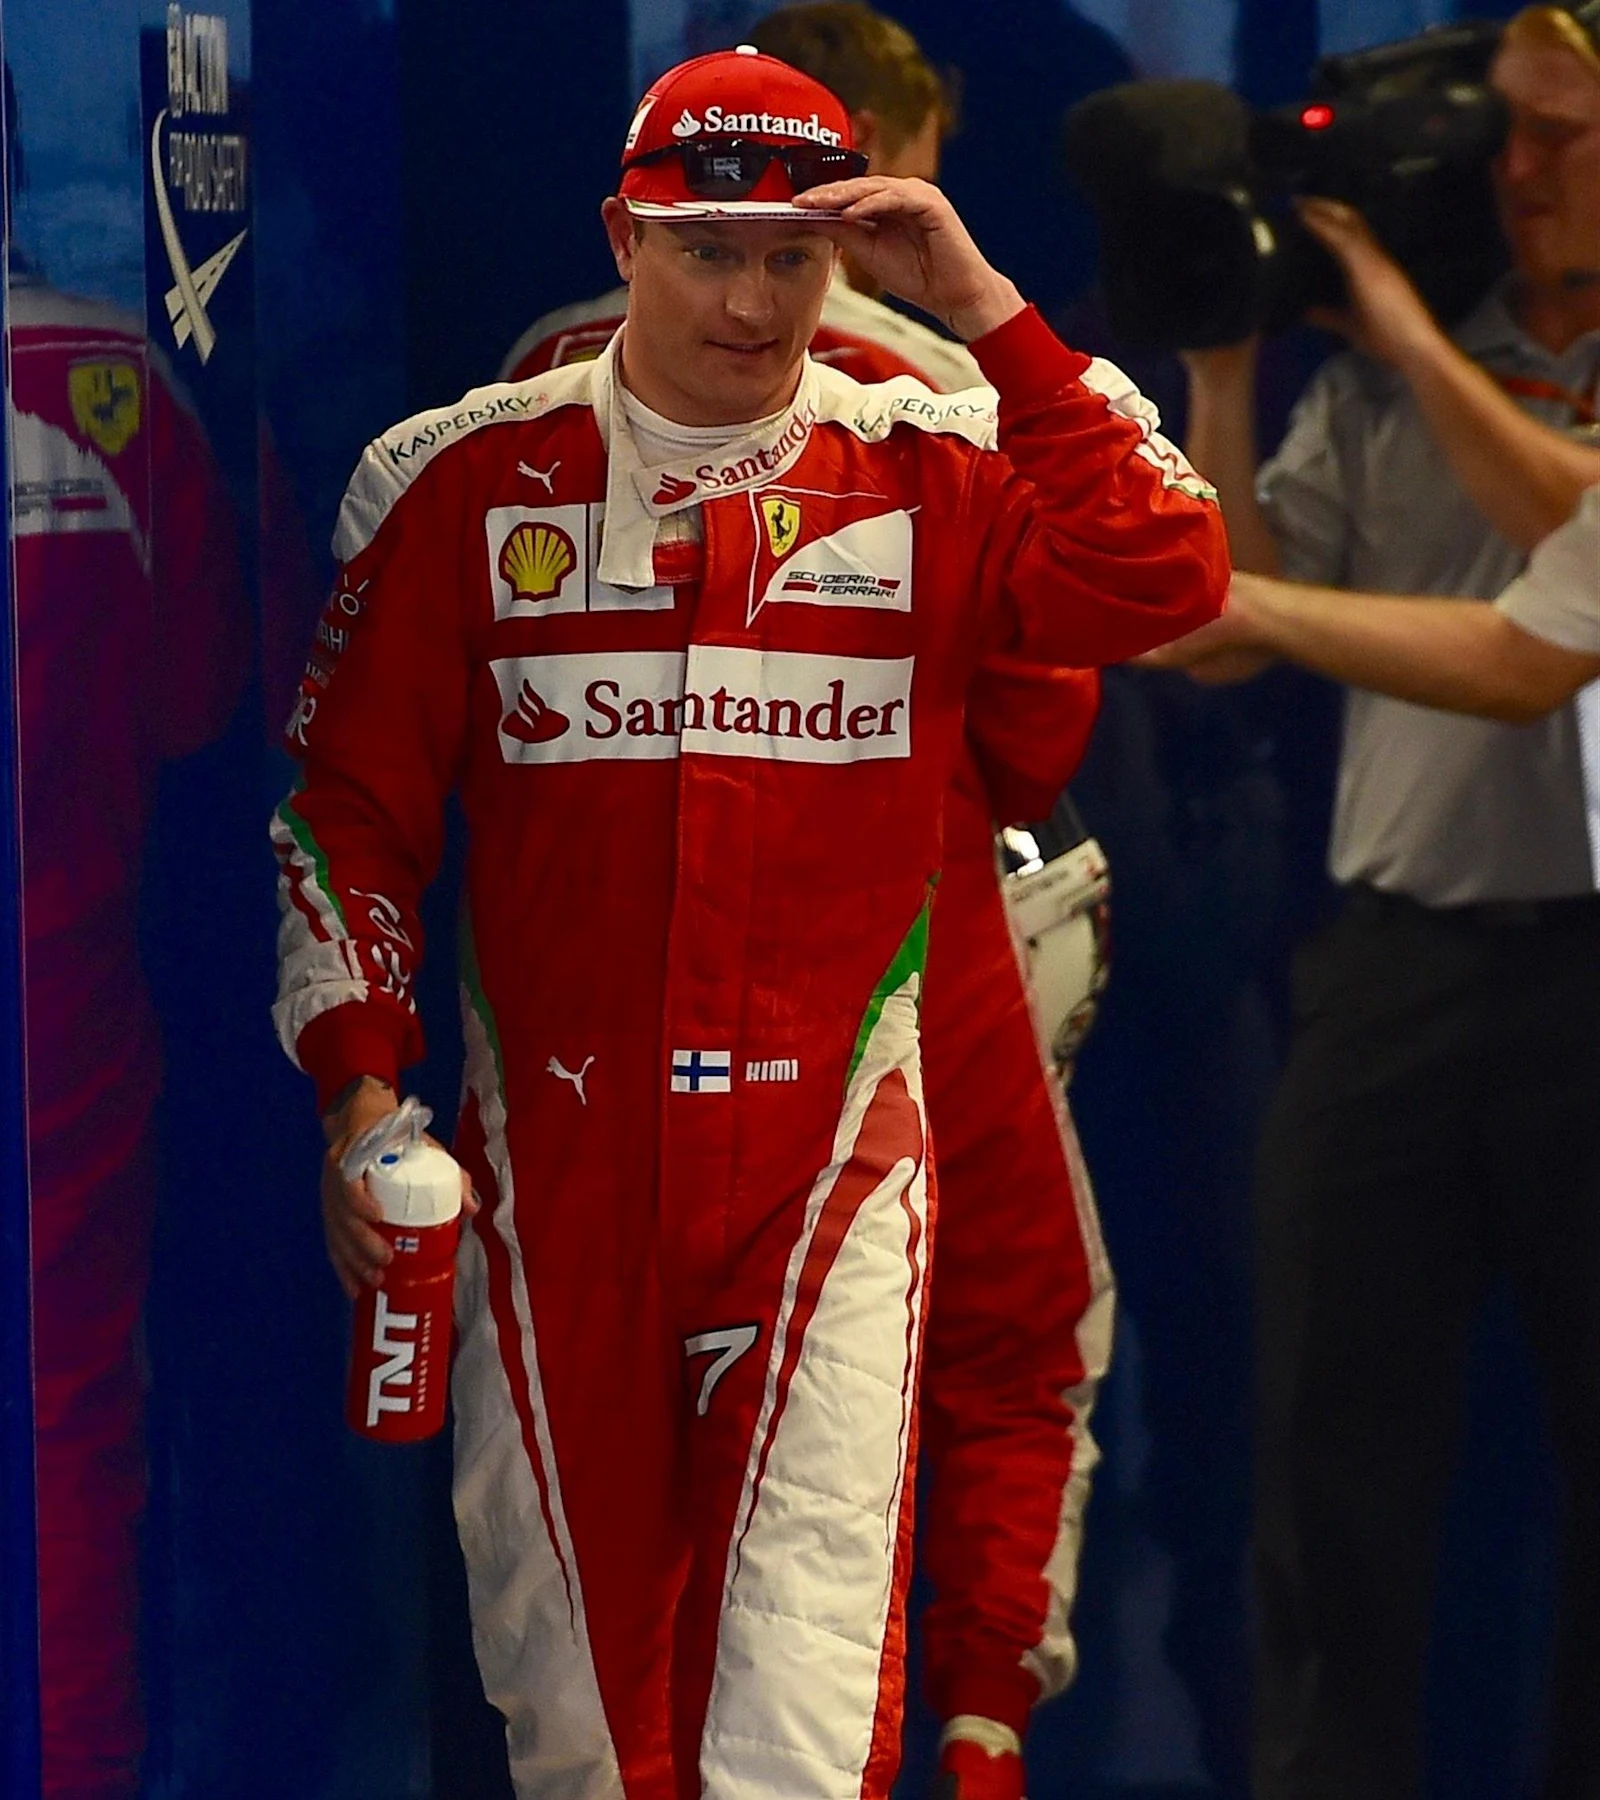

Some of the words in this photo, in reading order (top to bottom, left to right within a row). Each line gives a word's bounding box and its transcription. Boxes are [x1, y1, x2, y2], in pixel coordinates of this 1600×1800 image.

[703, 106, 841, 148] Santander
[388, 395, 534, 465] KASPERSKY
[787, 571, 876, 584] SCUDERIA
[819, 585, 896, 599] FERRARI
[585, 680, 904, 741] Santander
[366, 1290, 418, 1427] TNT
[685, 1326, 758, 1417] 7
